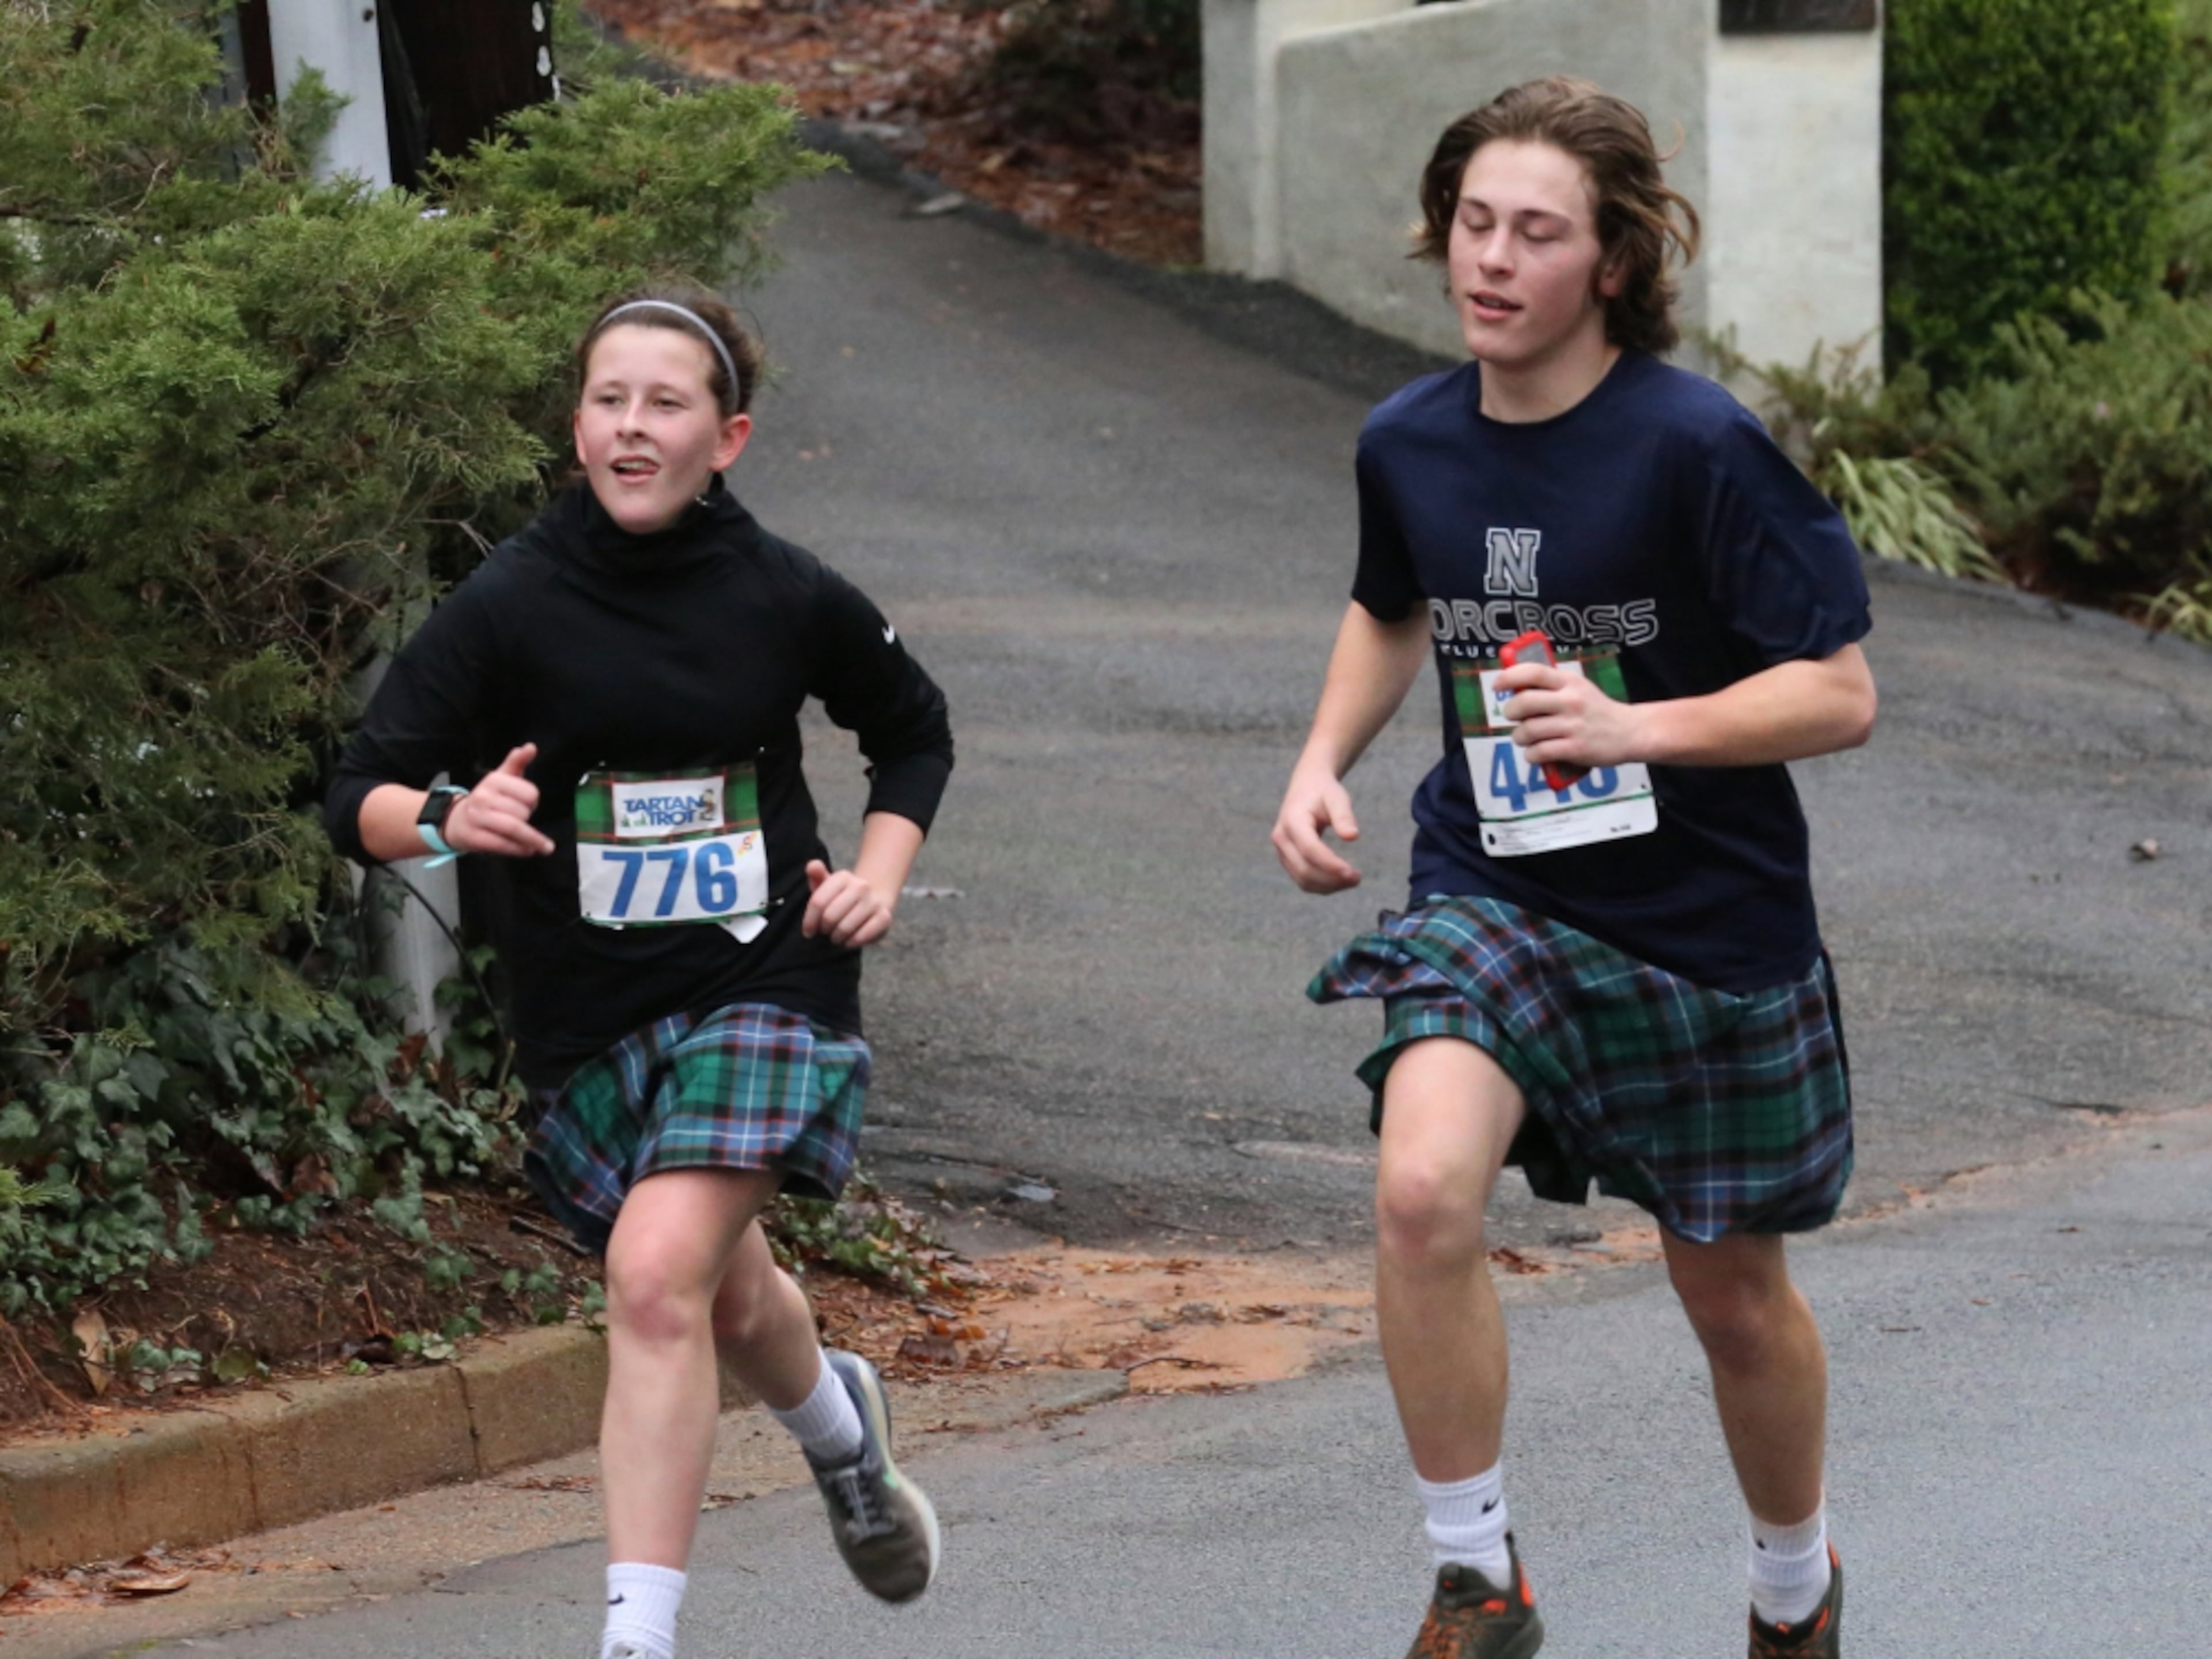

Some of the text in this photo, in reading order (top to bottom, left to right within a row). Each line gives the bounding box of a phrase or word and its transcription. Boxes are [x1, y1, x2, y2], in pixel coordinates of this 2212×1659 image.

[1484, 527, 1541, 596] N
[623, 795, 705, 813] TARTAN
[649, 809, 695, 826] TROT
[601, 841, 738, 918] 776
